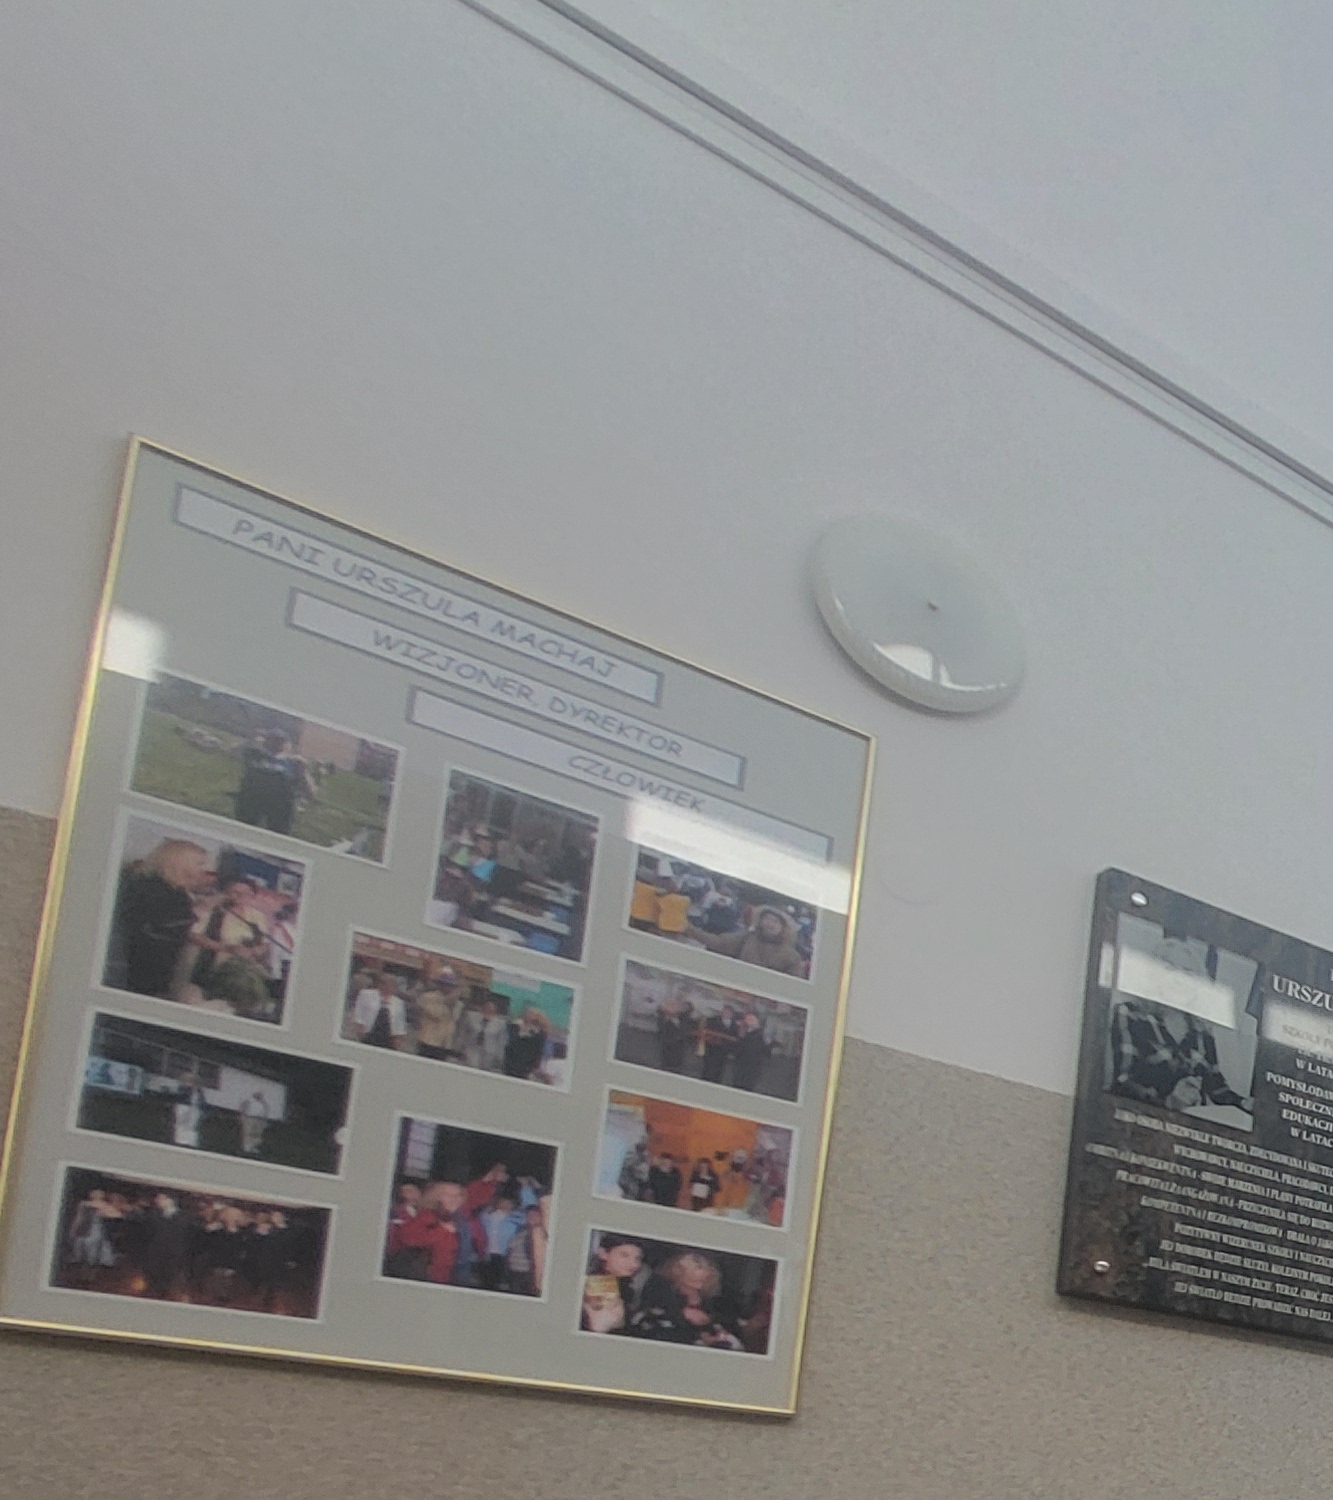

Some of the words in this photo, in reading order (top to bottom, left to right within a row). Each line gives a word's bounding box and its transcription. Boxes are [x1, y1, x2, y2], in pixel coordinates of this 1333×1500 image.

[232, 519, 326, 566] PANI
[332, 558, 481, 627] URSZULA
[489, 620, 619, 678] MACHAJ
[548, 696, 685, 757] DYREKTOR
[568, 754, 703, 813] CZŁOWIEK
[1295, 1058, 1305, 1071] W
[1281, 1108, 1333, 1133] EDUKACJI
[1290, 1126, 1301, 1139] W
